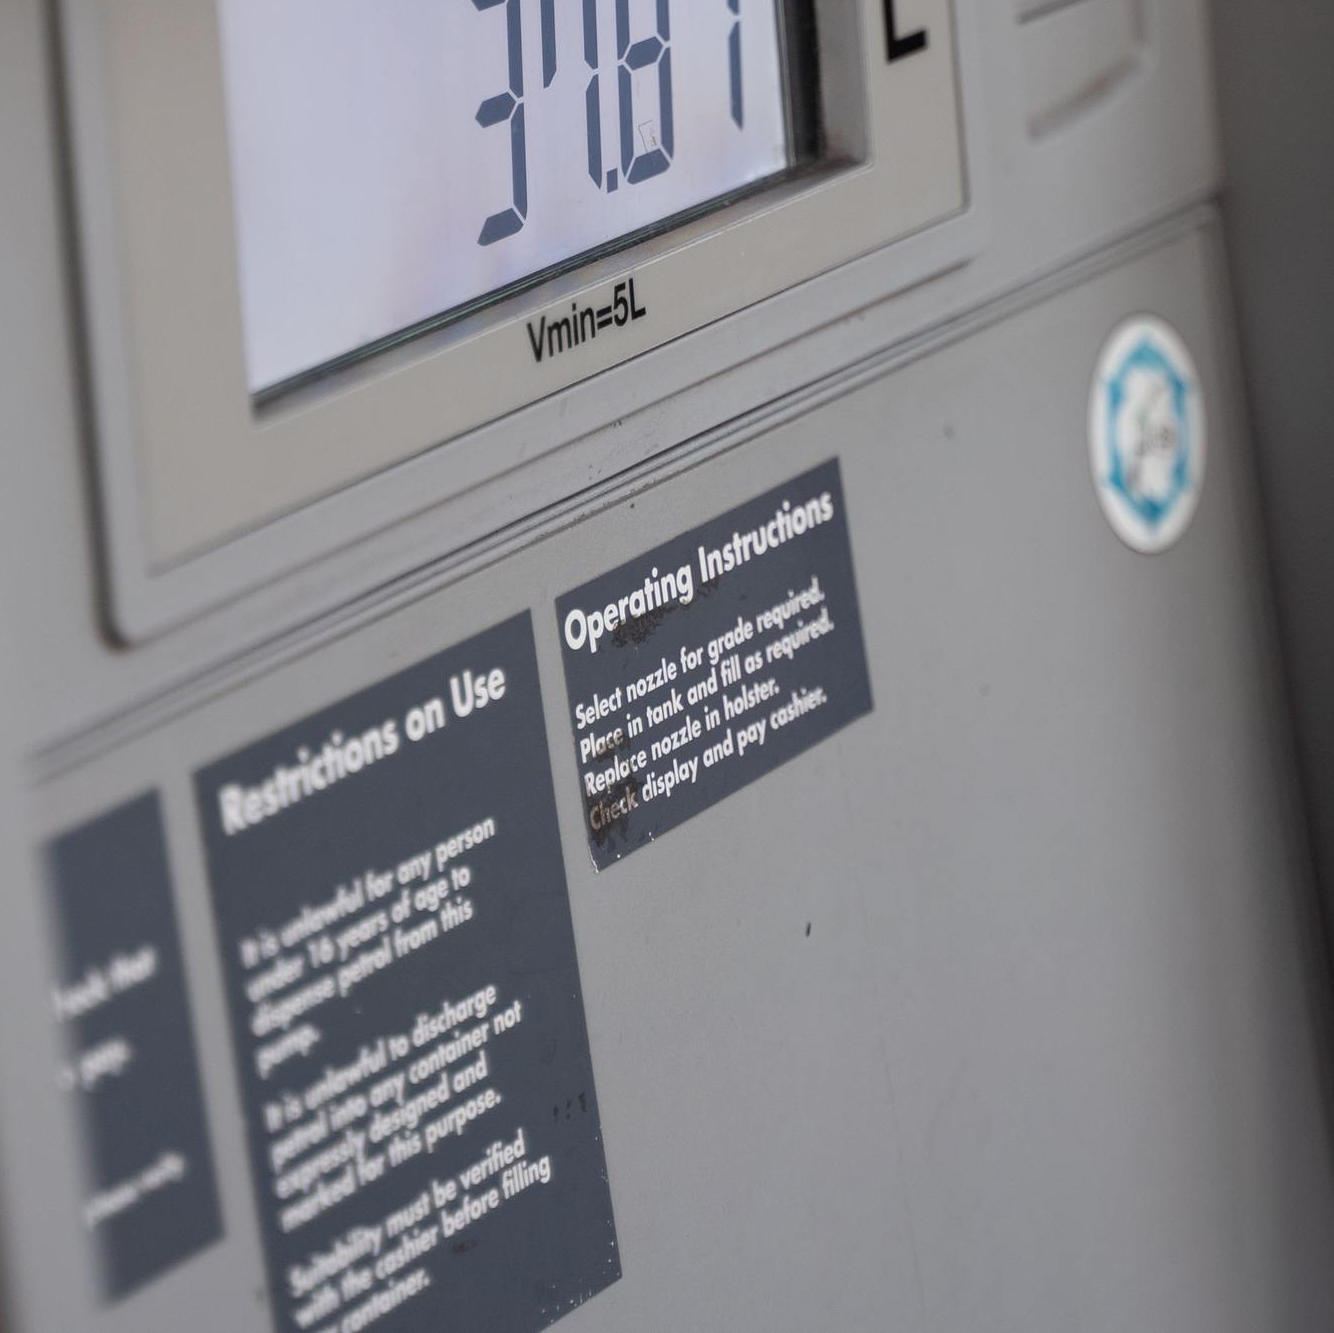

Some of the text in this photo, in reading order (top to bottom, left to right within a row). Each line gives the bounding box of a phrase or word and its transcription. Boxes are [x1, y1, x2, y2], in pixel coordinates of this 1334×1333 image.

[527, 278, 647, 363] Vmin=5L
[564, 491, 834, 653] Operating Instructions
[575, 575, 825, 730] Select nozzle for grade required.
[580, 606, 835, 764] Place in tank and fill as required.
[219, 668, 507, 836] Restrictions on Use
[584, 677, 780, 798] Replace nozzle in holster.
[589, 686, 828, 831] Check display and pay cashier.
[279, 877, 365, 948] unlawful
[365, 869, 394, 902] for
[396, 851, 433, 882] any
[435, 817, 496, 873] person
[307, 933, 336, 969] 16
[336, 911, 390, 963] years
[391, 888, 412, 924] of
[413, 877, 450, 913] age
[452, 865, 471, 891] to
[336, 934, 394, 998] petrol
[392, 918, 440, 959] from
[440, 896, 474, 933] this
[304, 1035, 389, 1111] unlawful
[389, 1033, 410, 1062] to
[412, 984, 498, 1048] discharge
[368, 1072, 451, 1145] designed
[453, 1050, 489, 1094] and
[369, 1073, 407, 1107] any
[408, 1022, 490, 1085] container
[493, 998, 523, 1035] not
[355, 1154, 386, 1187] for
[388, 1130, 423, 1168] this
[425, 1088, 503, 1155] purpose.
[384, 1188, 432, 1239] must
[431, 1178, 458, 1210] be
[459, 1126, 527, 1190] verified
[373, 1223, 439, 1281] cashier
[440, 1187, 501, 1239] before
[501, 1154, 552, 1201] filling
